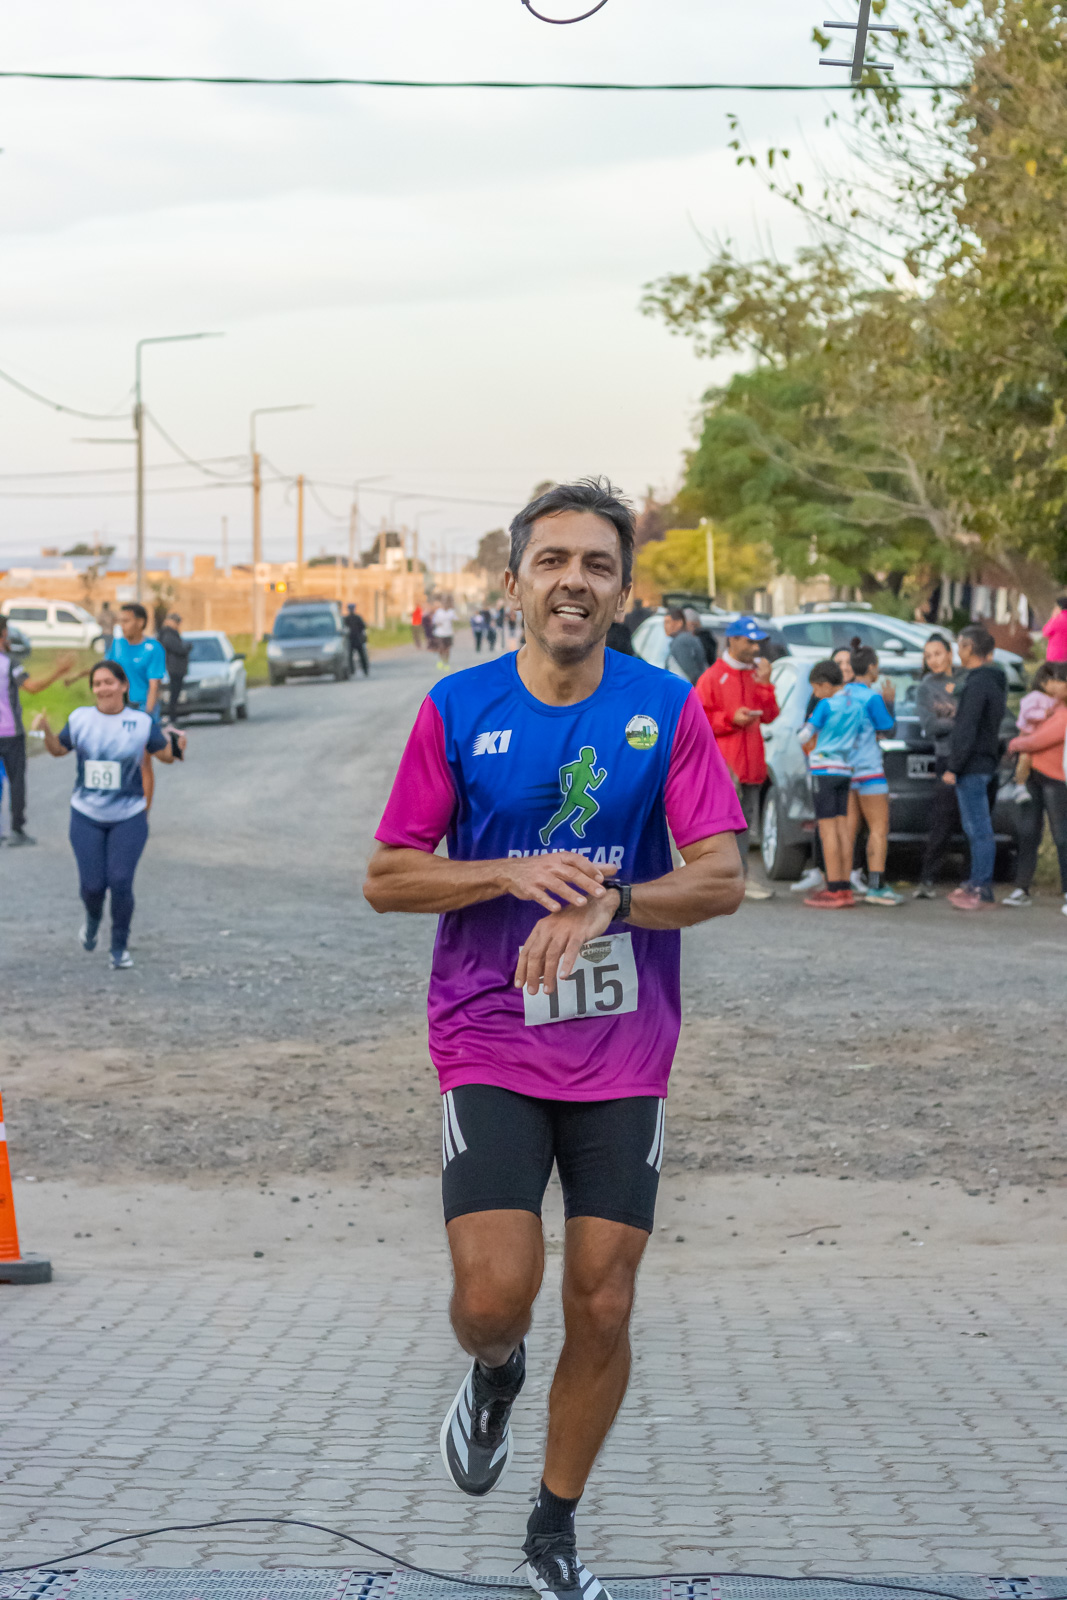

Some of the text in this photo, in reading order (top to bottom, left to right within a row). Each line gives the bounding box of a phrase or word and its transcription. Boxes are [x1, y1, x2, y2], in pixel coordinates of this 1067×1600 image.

[472, 729, 512, 757] K1
[91, 769, 113, 788] 69
[539, 963, 624, 1019] 115
